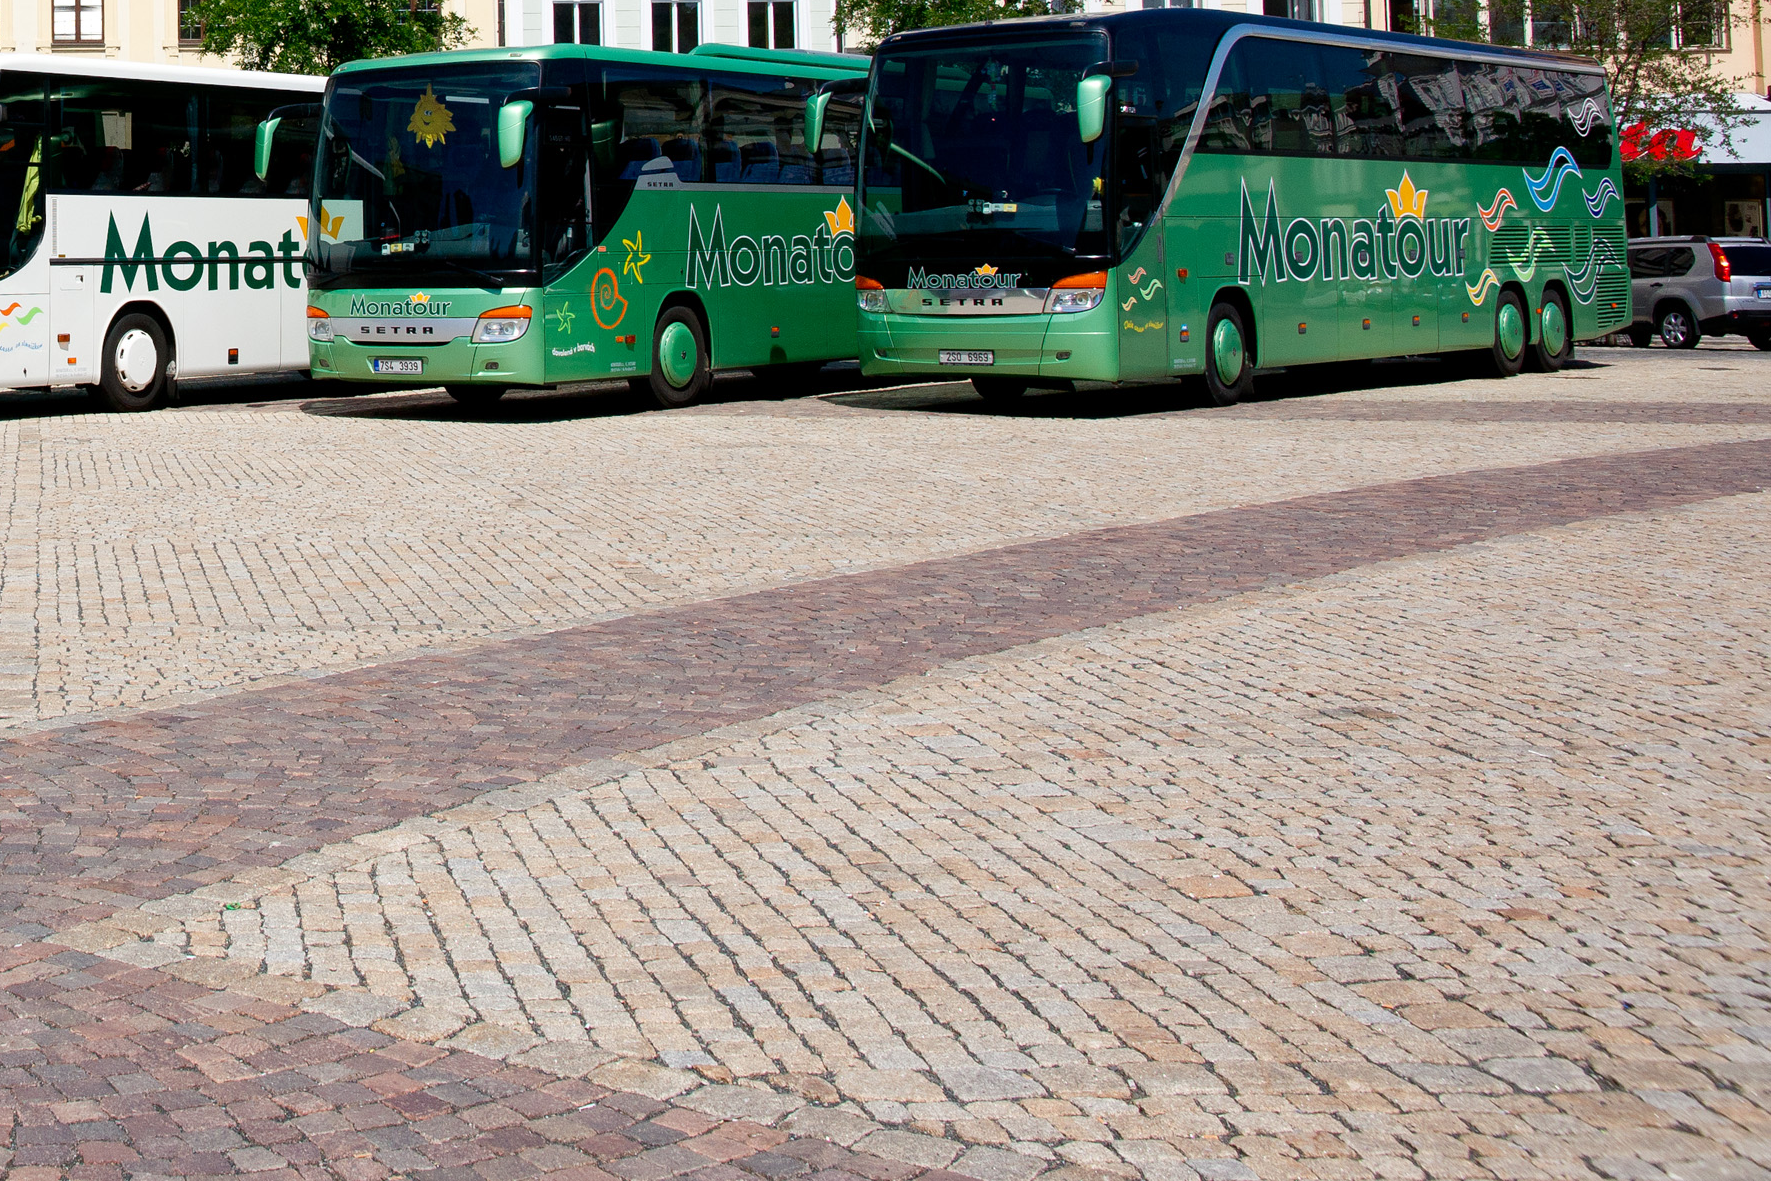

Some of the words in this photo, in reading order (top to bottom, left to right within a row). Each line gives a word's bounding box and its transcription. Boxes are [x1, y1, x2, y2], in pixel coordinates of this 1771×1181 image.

[1238, 176, 1470, 287] Monatour
[907, 266, 1022, 289] Monatour
[350, 294, 452, 317] Monatour
[360, 326, 434, 335] SETRA
[380, 360, 394, 371] 7S4
[399, 360, 419, 371] 3939
[968, 352, 989, 362] 6969
